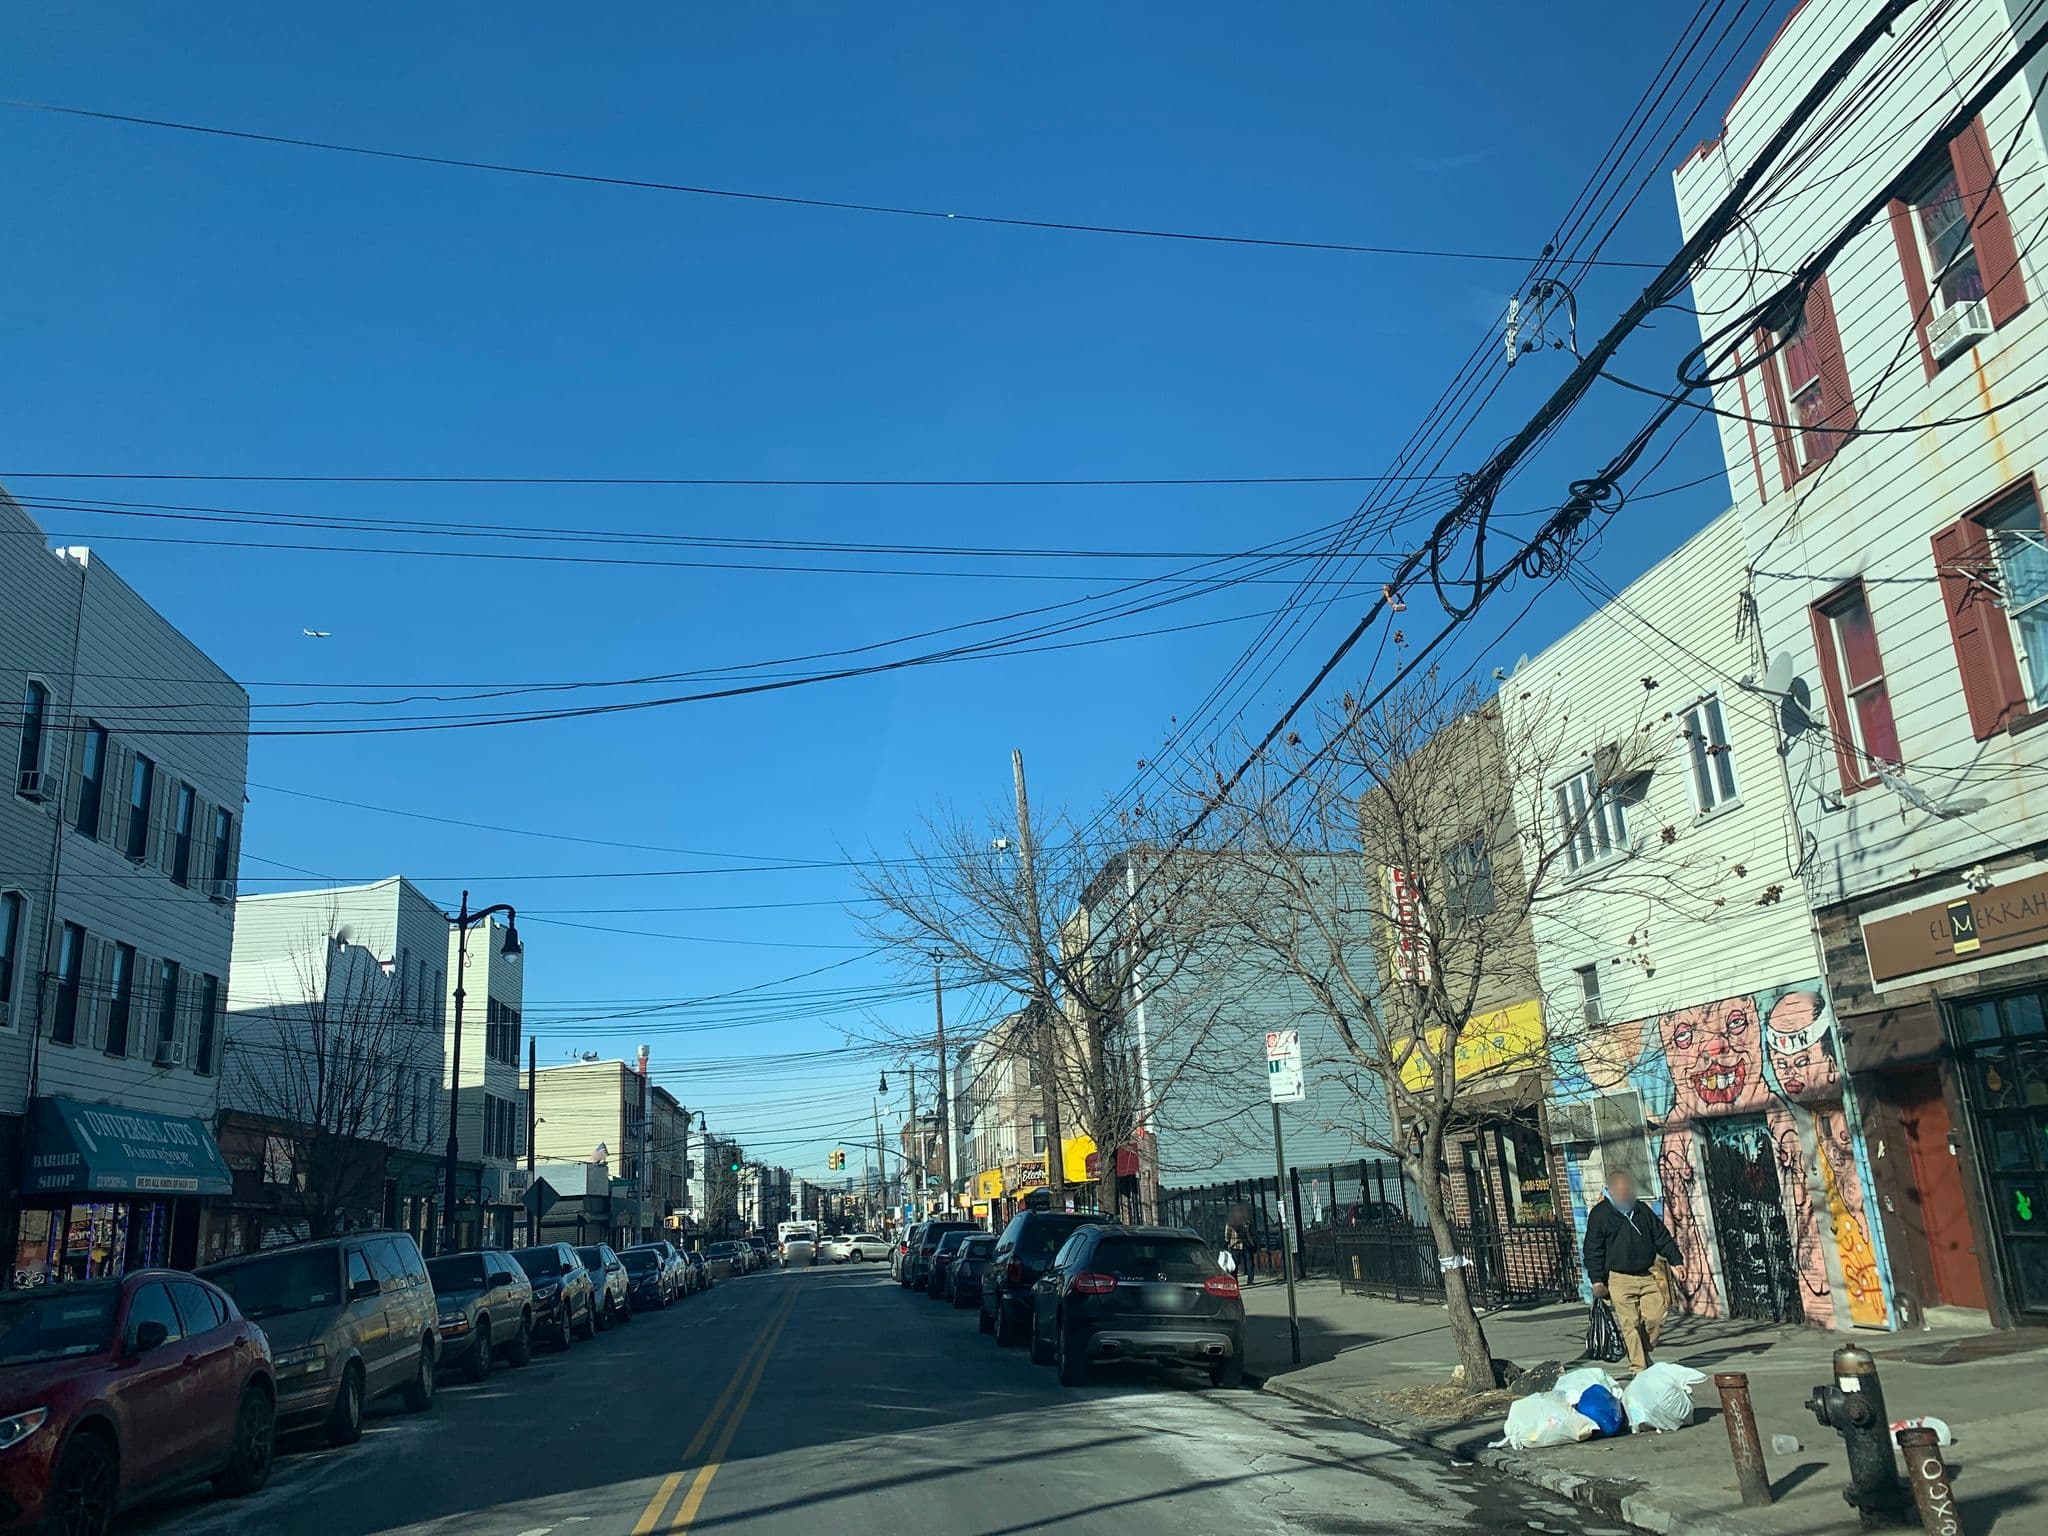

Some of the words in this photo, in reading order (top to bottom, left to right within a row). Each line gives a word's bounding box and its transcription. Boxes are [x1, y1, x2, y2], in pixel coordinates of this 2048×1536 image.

[1929, 919, 1950, 941] EL
[83, 1110, 168, 1143] UNIVERSAL
[164, 1121, 198, 1146] CUTS
[32, 1152, 80, 1168] BARBER
[37, 1174, 76, 1189] SHOP
